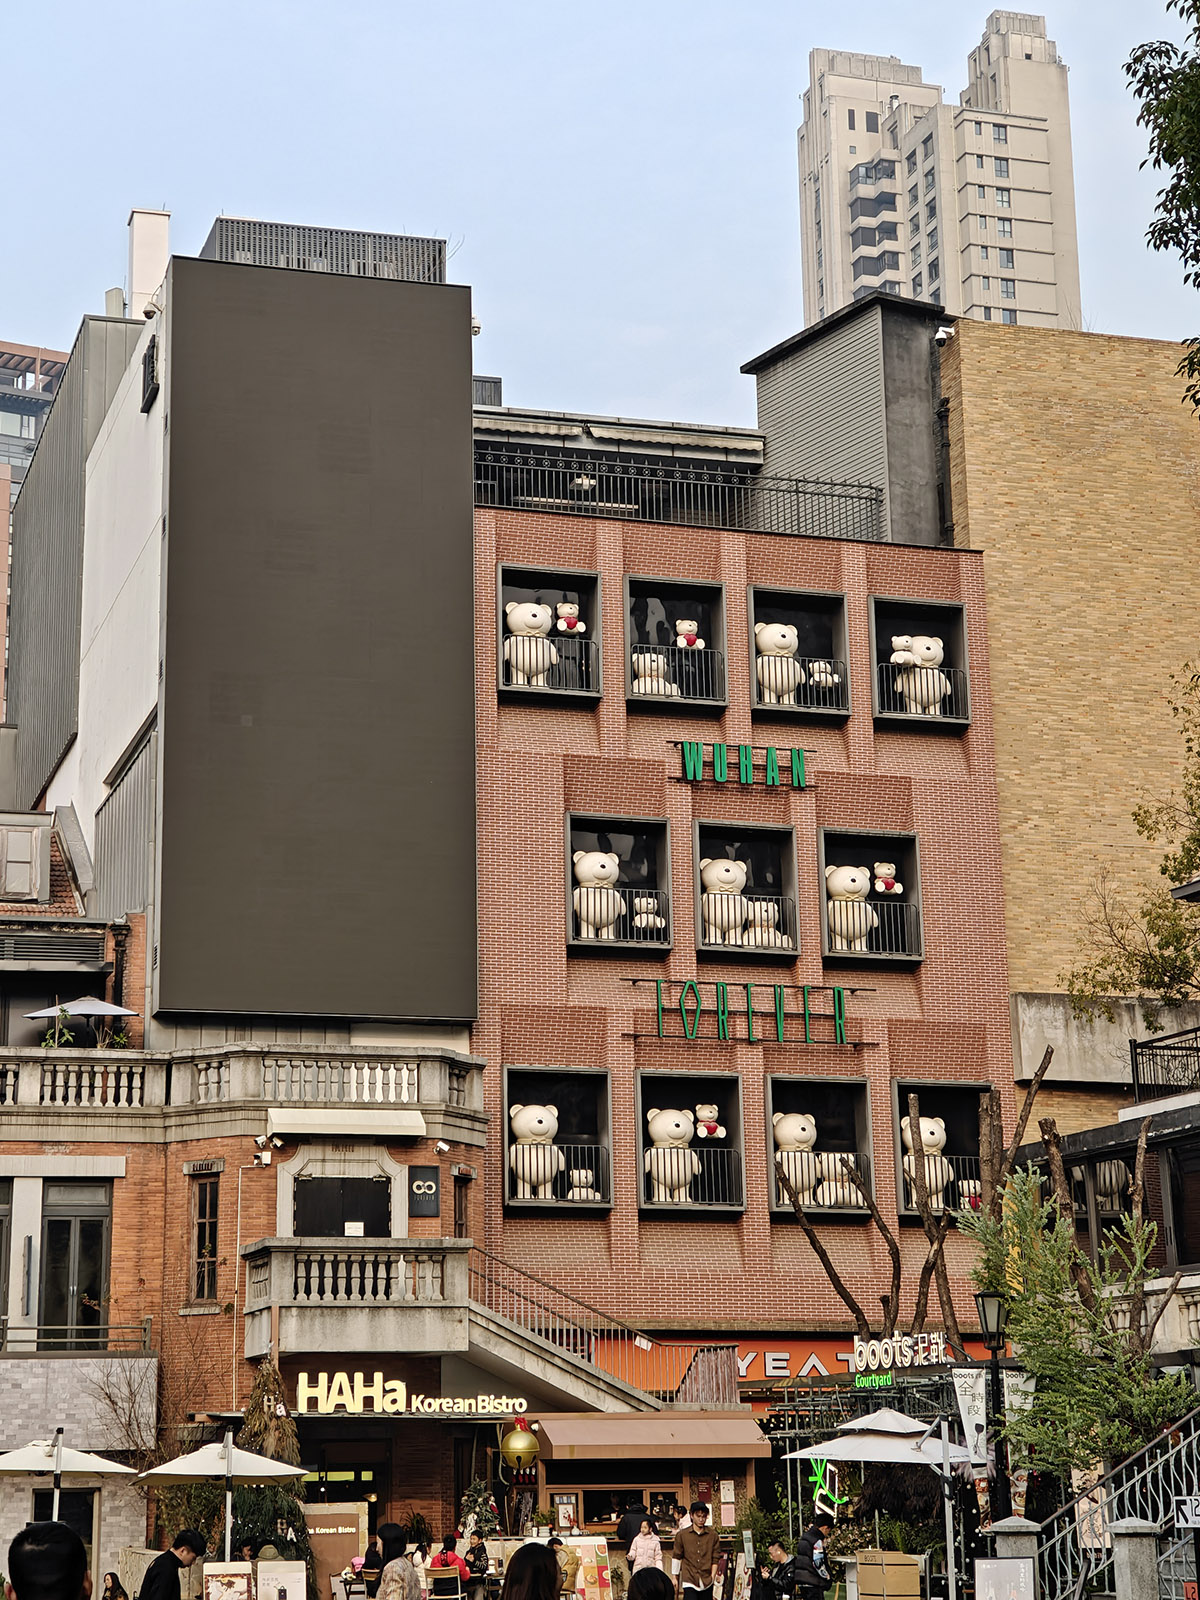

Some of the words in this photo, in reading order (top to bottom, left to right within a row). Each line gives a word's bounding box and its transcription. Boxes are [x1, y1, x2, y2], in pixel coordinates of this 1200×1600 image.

[682, 740, 806, 788] WUHAN
[656, 979, 847, 1045] FOREVER
[853, 1330, 913, 1371] boots
[913, 1331, 946, 1366] 泥靴
[297, 1372, 407, 1414] HAHa
[855, 1371, 892, 1389] Courtyard
[958, 1381, 984, 1416] 全時段
[411, 1394, 476, 1413] Korean
[477, 1395, 528, 1413] Bistro
[338, 1526, 357, 1534] Bistro
